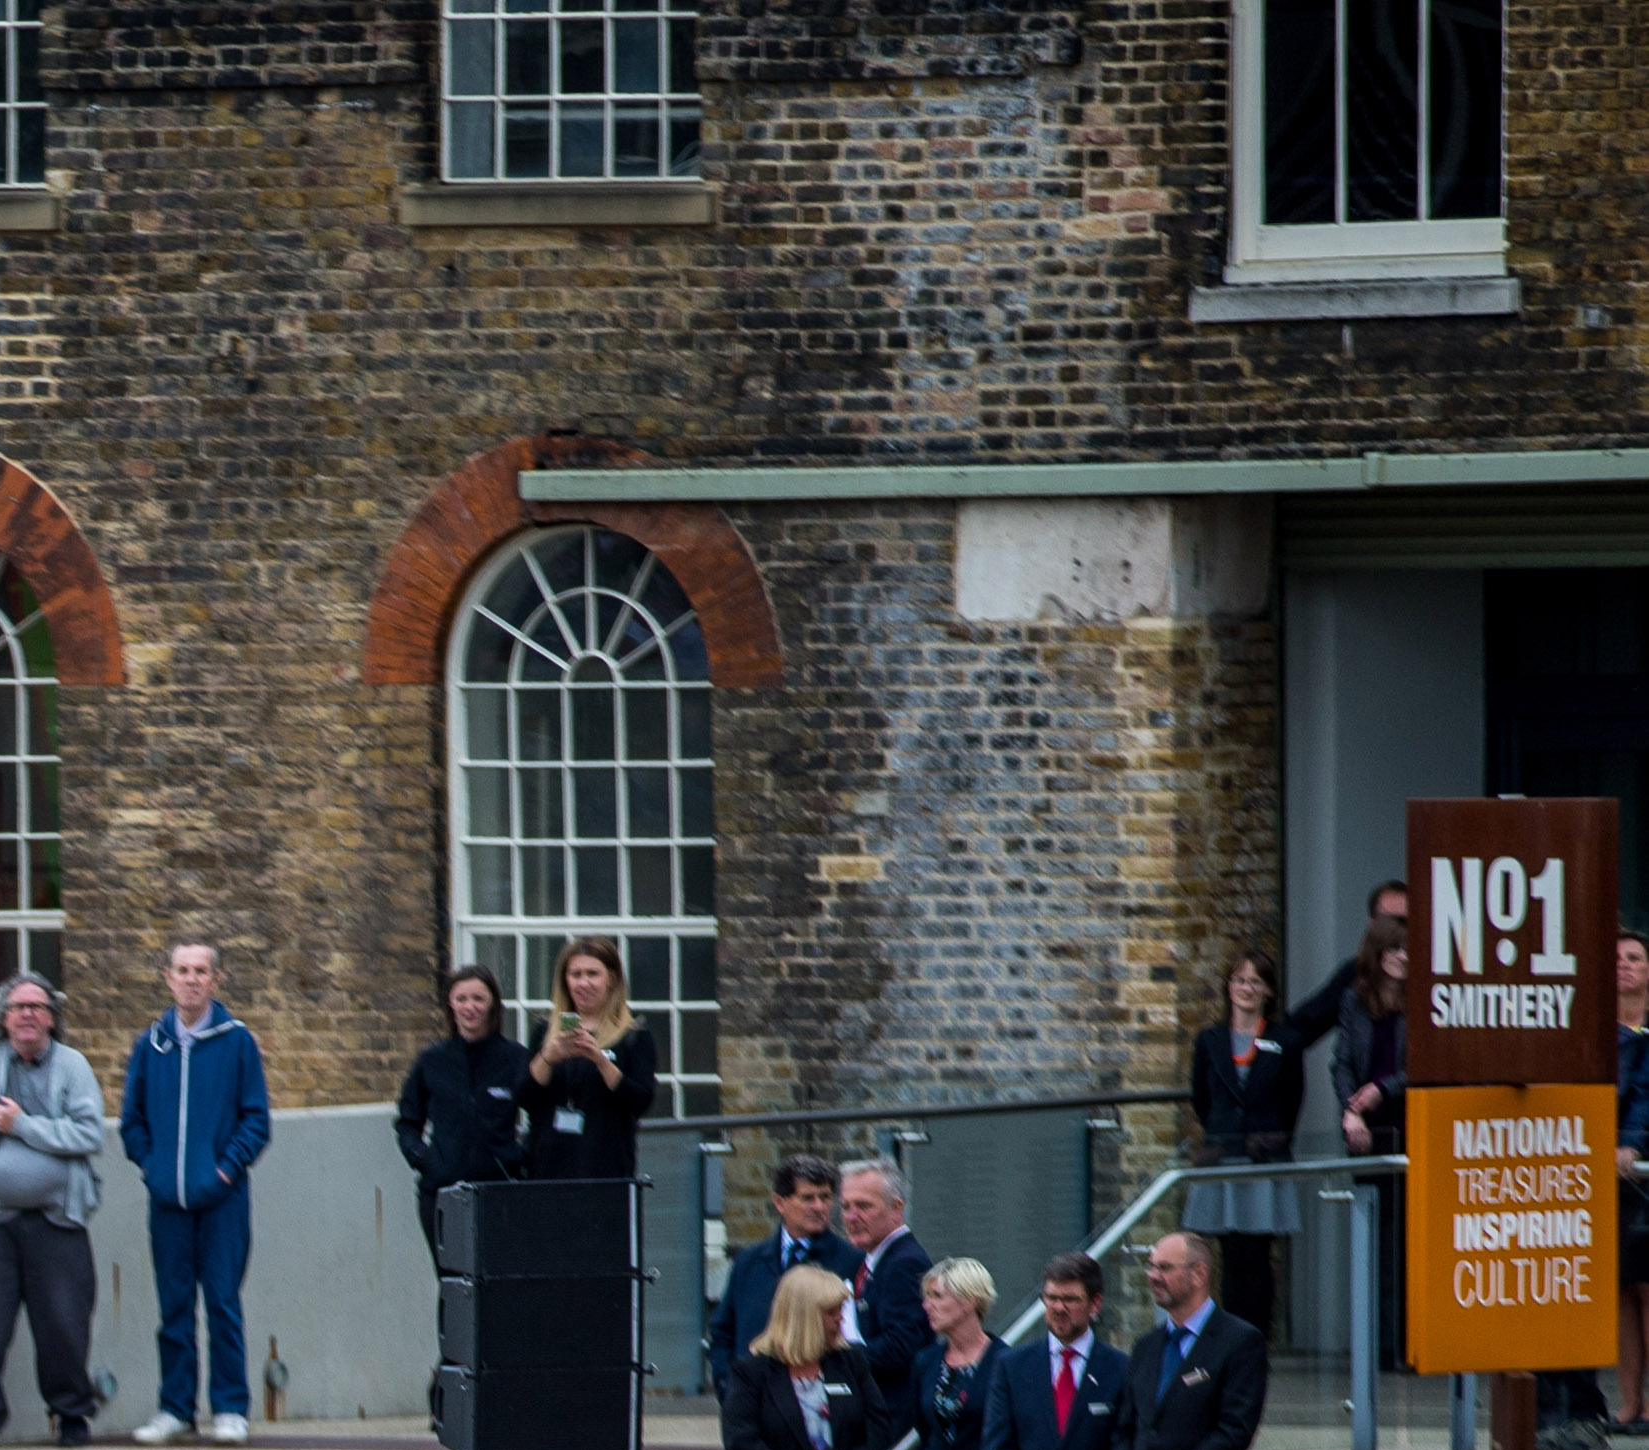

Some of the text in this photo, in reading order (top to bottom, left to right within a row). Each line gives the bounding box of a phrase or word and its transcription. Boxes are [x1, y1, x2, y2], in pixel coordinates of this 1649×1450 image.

[1431, 983, 1575, 1028] SMITHERY
[1453, 1116, 1592, 1159] NATIONAL
[1453, 1163, 1592, 1205] TREASURES
[1453, 1209, 1592, 1252] INSPIRING
[1454, 1256, 1592, 1308] CULTURE
